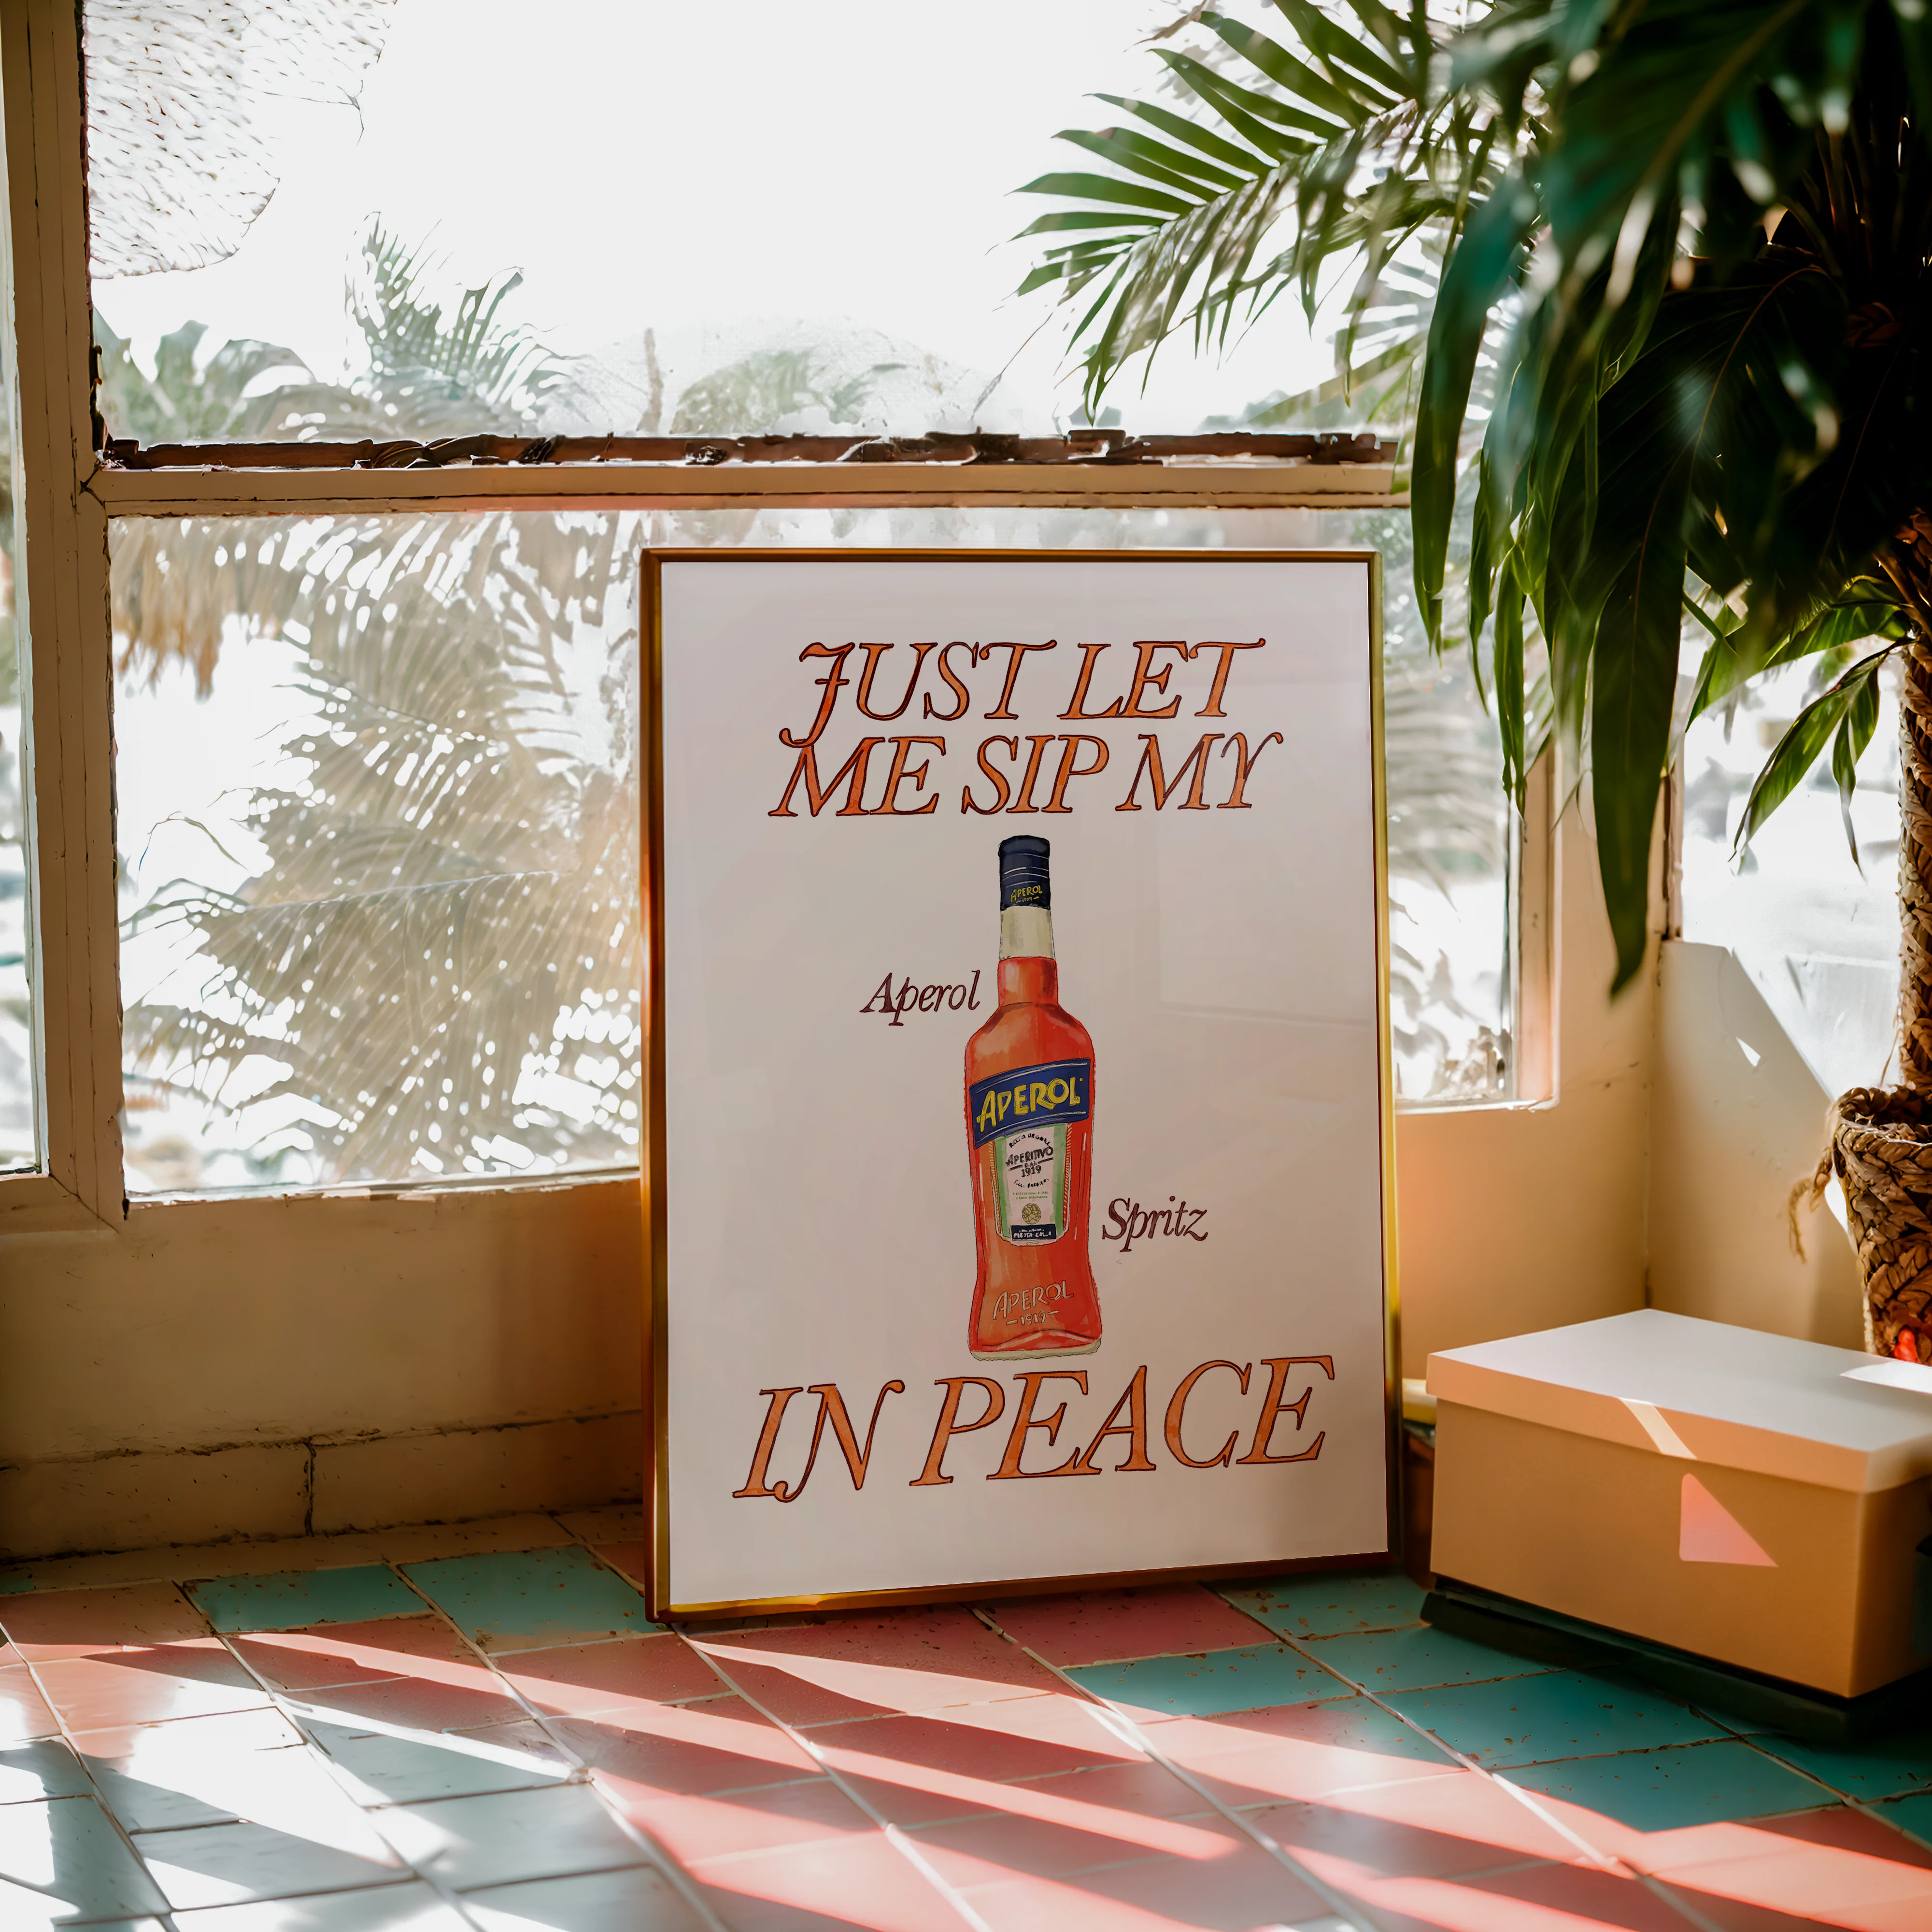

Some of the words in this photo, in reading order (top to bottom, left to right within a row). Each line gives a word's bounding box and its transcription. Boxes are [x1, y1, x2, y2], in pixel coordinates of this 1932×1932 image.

[779, 639, 1057, 748] JUST
[1056, 638, 1266, 720] LET
[767, 736, 946, 817] ME
[961, 734, 1109, 815] SIP
[1115, 732, 1284, 811] MY
[1010, 884, 1043, 903] APEROL
[859, 970, 980, 1026] Aperol
[976, 1077, 1081, 1133] APEROL
[1006, 1146, 1054, 1166] APERITIVO
[1021, 1165, 1041, 1178] 1919
[1102, 1196, 1208, 1253] Spritz
[993, 1280, 1074, 1320] APEROL
[1021, 1310, 1046, 1325] 1919
[732, 1379, 906, 1503] IN
[909, 1354, 1335, 1487] PEACE
